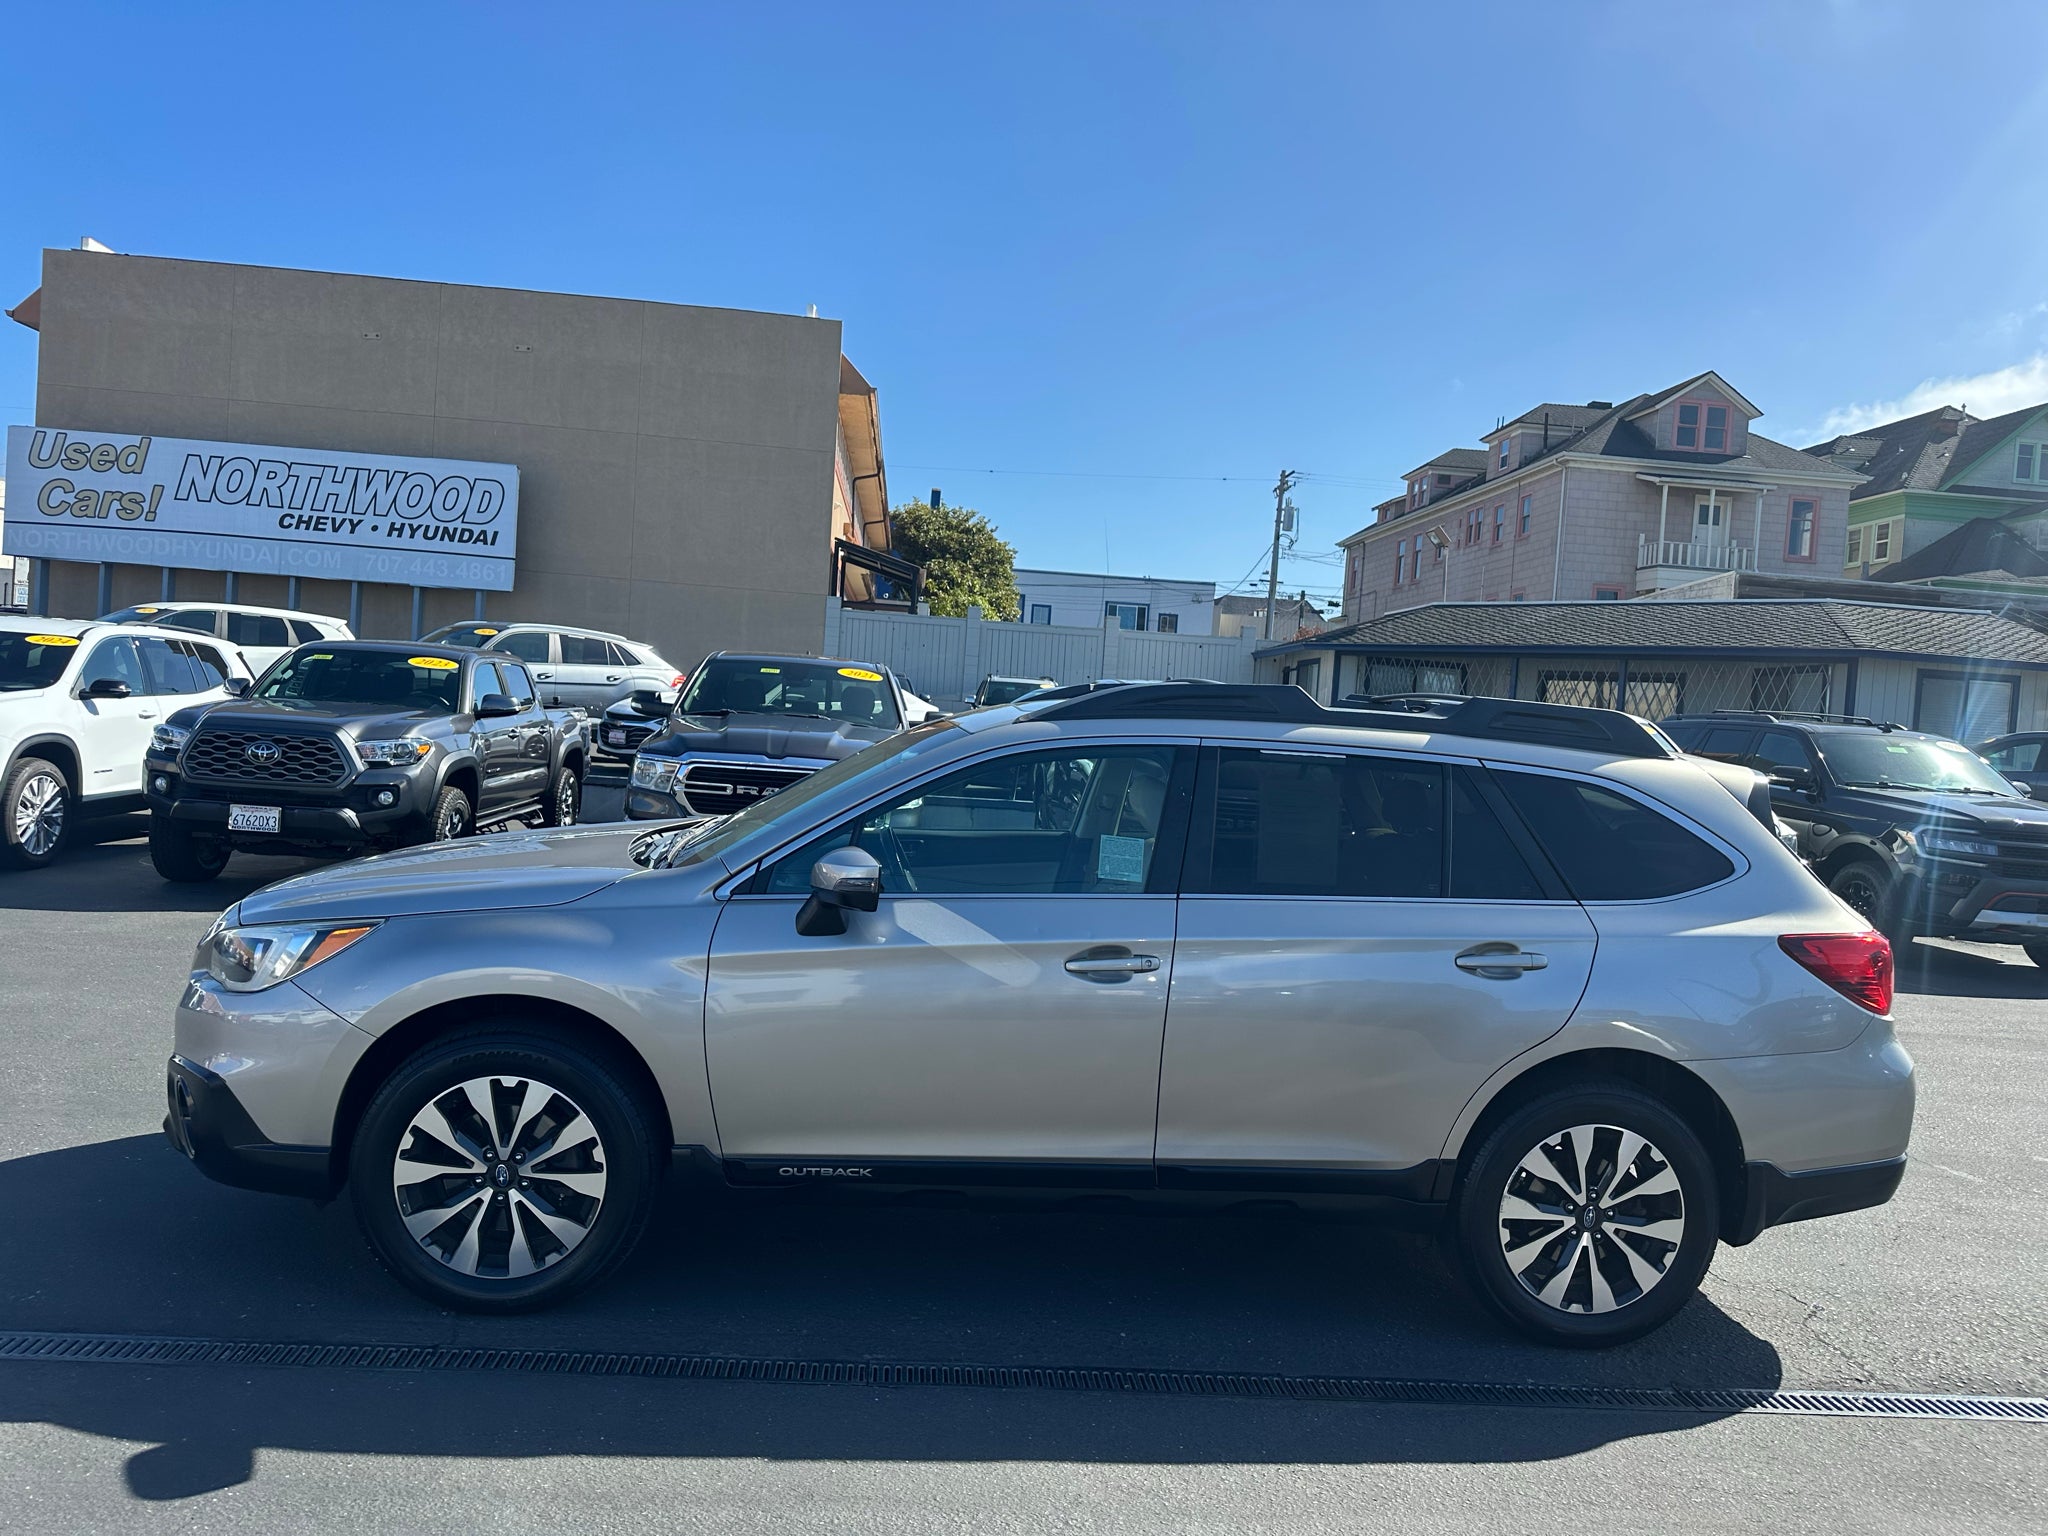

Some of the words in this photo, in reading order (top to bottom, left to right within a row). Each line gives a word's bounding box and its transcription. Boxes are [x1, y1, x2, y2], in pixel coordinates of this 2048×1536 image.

[28, 430, 152, 475] Used
[174, 453, 505, 525] NORTHWOOD
[37, 478, 165, 522] Cars!
[278, 513, 364, 535] CHEVY
[386, 521, 499, 546] HYUNDAI
[8, 528, 342, 569] NORTHWOODHYUNDAI.COM
[364, 554, 506, 582] 707.443.4861
[35, 636, 72, 644] 2024
[419, 658, 450, 667] 2023
[847, 670, 875, 679] 2021
[736, 785, 782, 796] RA
[232, 814, 277, 828] 67620X3
[779, 1167, 873, 1177] OUTBACK
